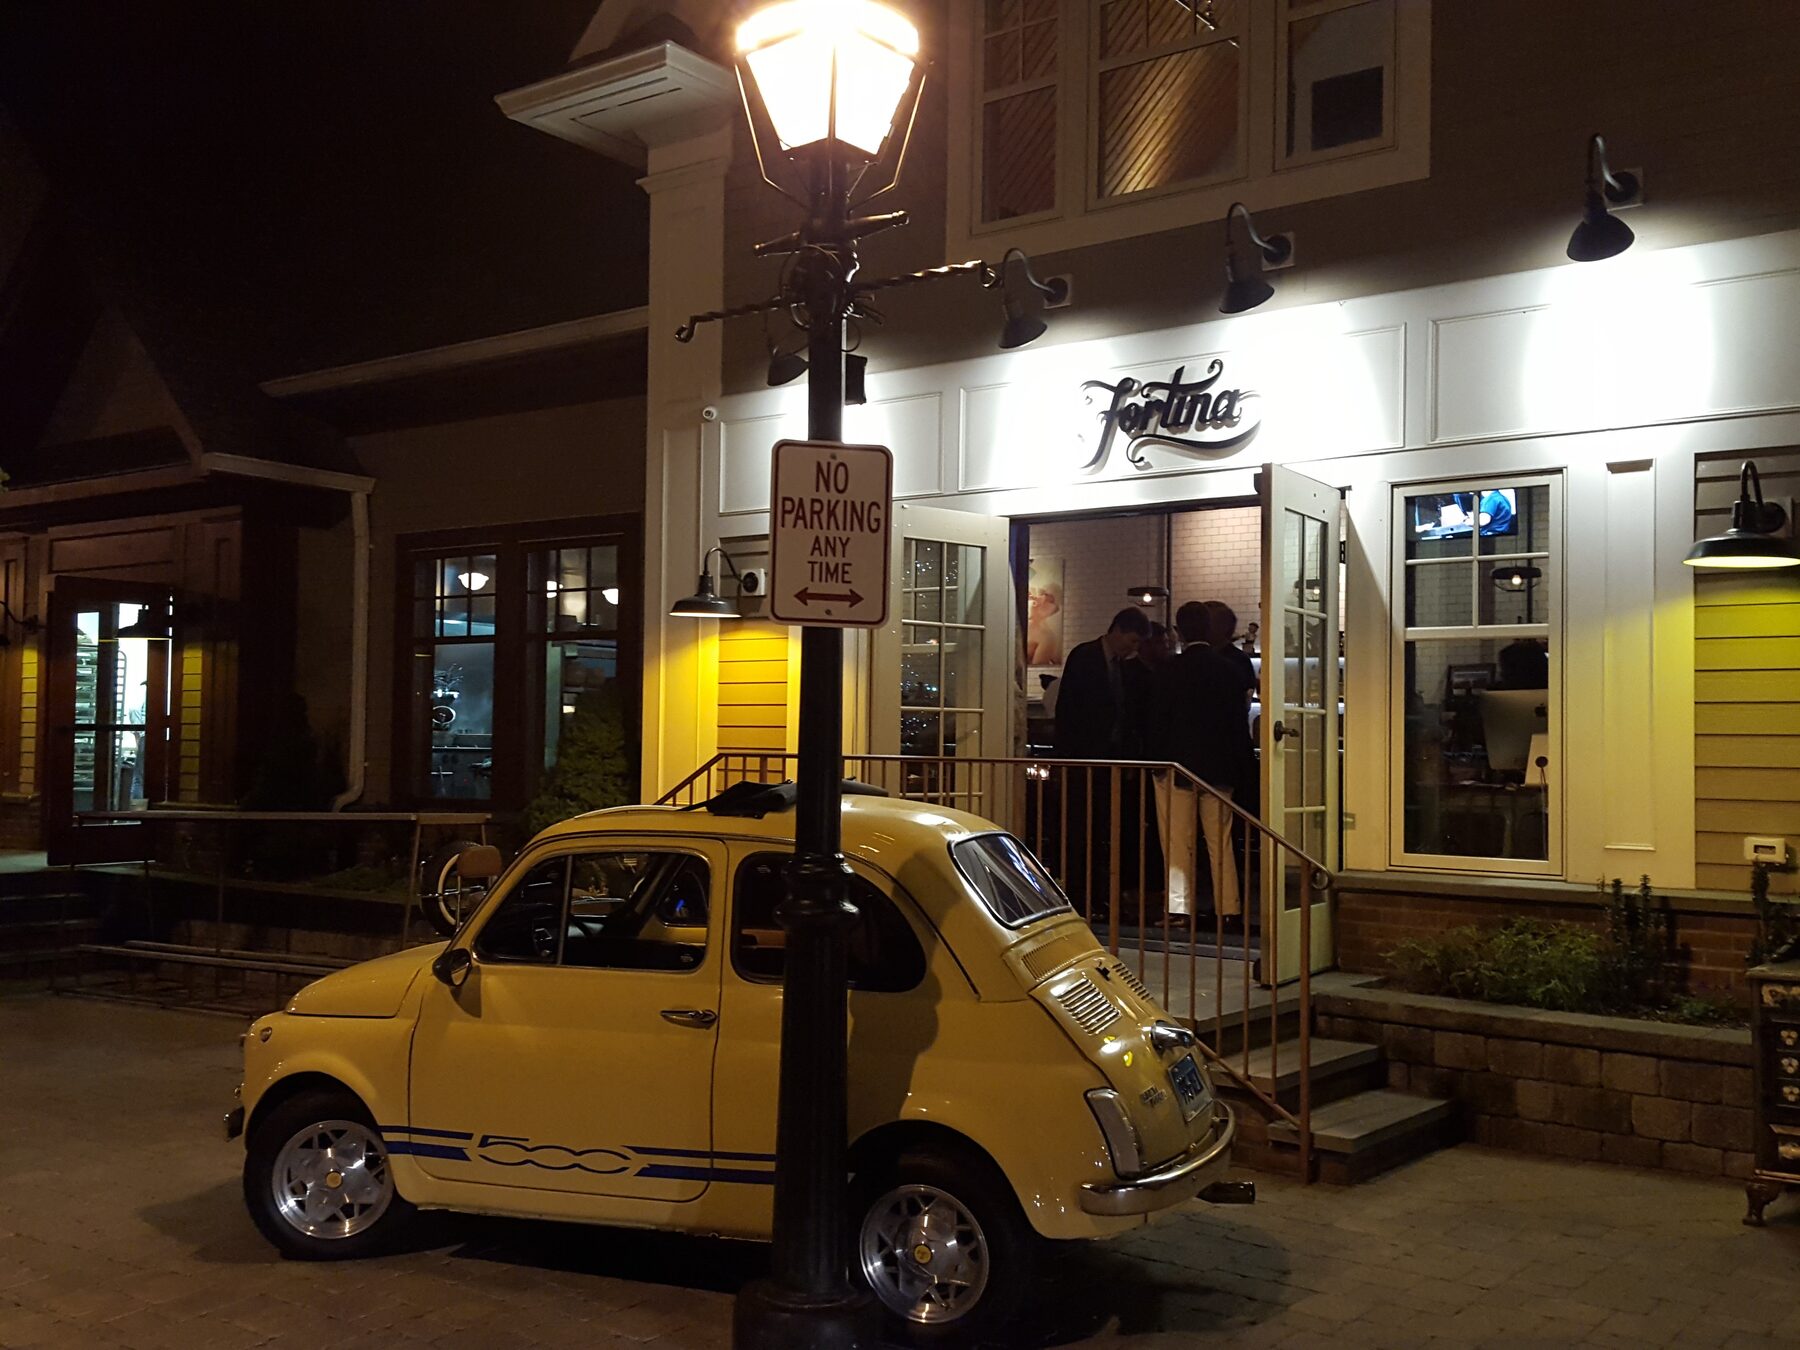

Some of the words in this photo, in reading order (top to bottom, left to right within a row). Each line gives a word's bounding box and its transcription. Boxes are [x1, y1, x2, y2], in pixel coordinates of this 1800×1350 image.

[815, 460, 849, 494] NO
[780, 496, 882, 534] PARKING
[810, 535, 851, 558] ANY
[807, 560, 853, 584] TIME
